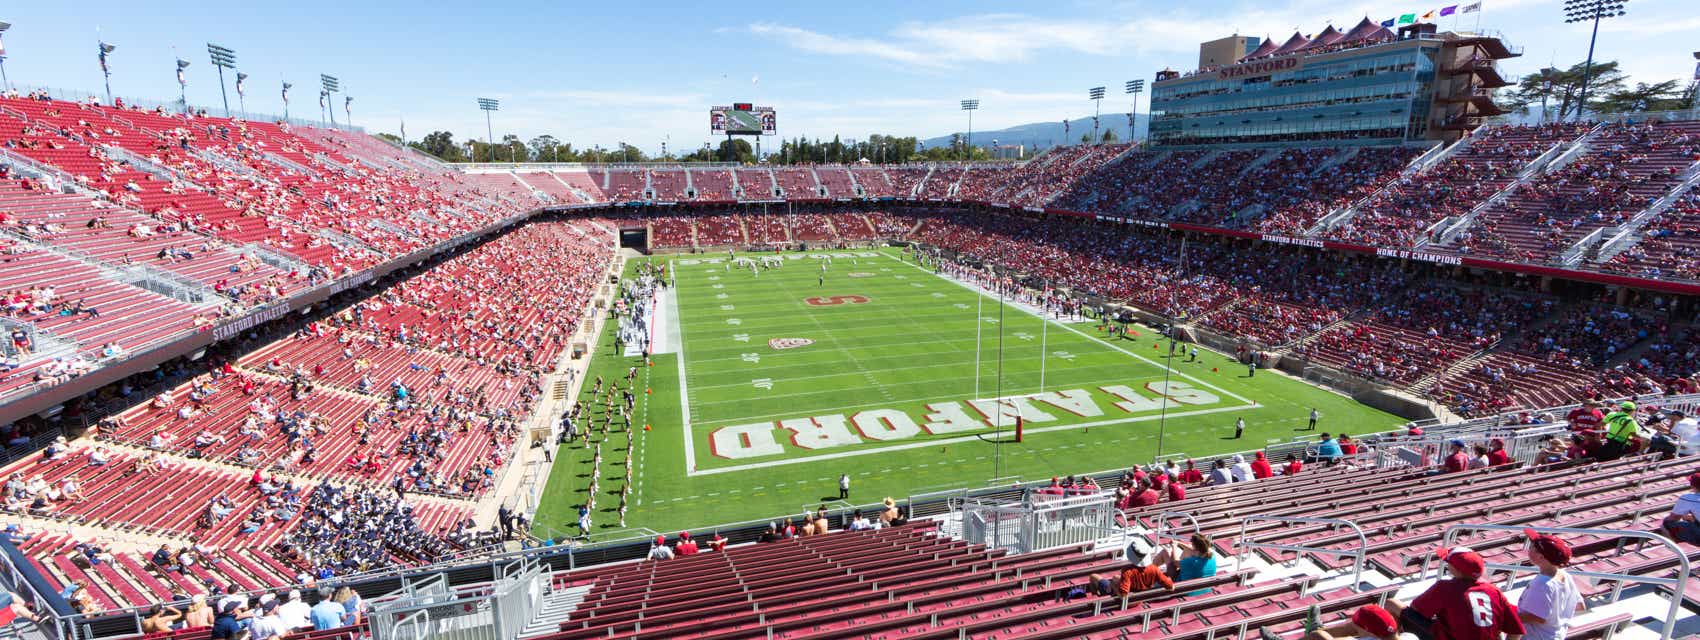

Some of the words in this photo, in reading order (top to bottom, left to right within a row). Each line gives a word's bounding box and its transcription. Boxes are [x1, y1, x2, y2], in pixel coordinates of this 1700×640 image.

[1220, 57, 1297, 79] STANFORD
[1261, 234, 1290, 244] STANFORD
[1291, 237, 1324, 248] ATHLETICS
[1376, 247, 1399, 258] HOME
[1400, 249, 1410, 259] OF
[1412, 251, 1463, 265] CHAMPIONS
[212, 314, 254, 342] STANFORD
[254, 302, 291, 327] ATHLETICS
[708, 380, 1220, 460] STANFORD
